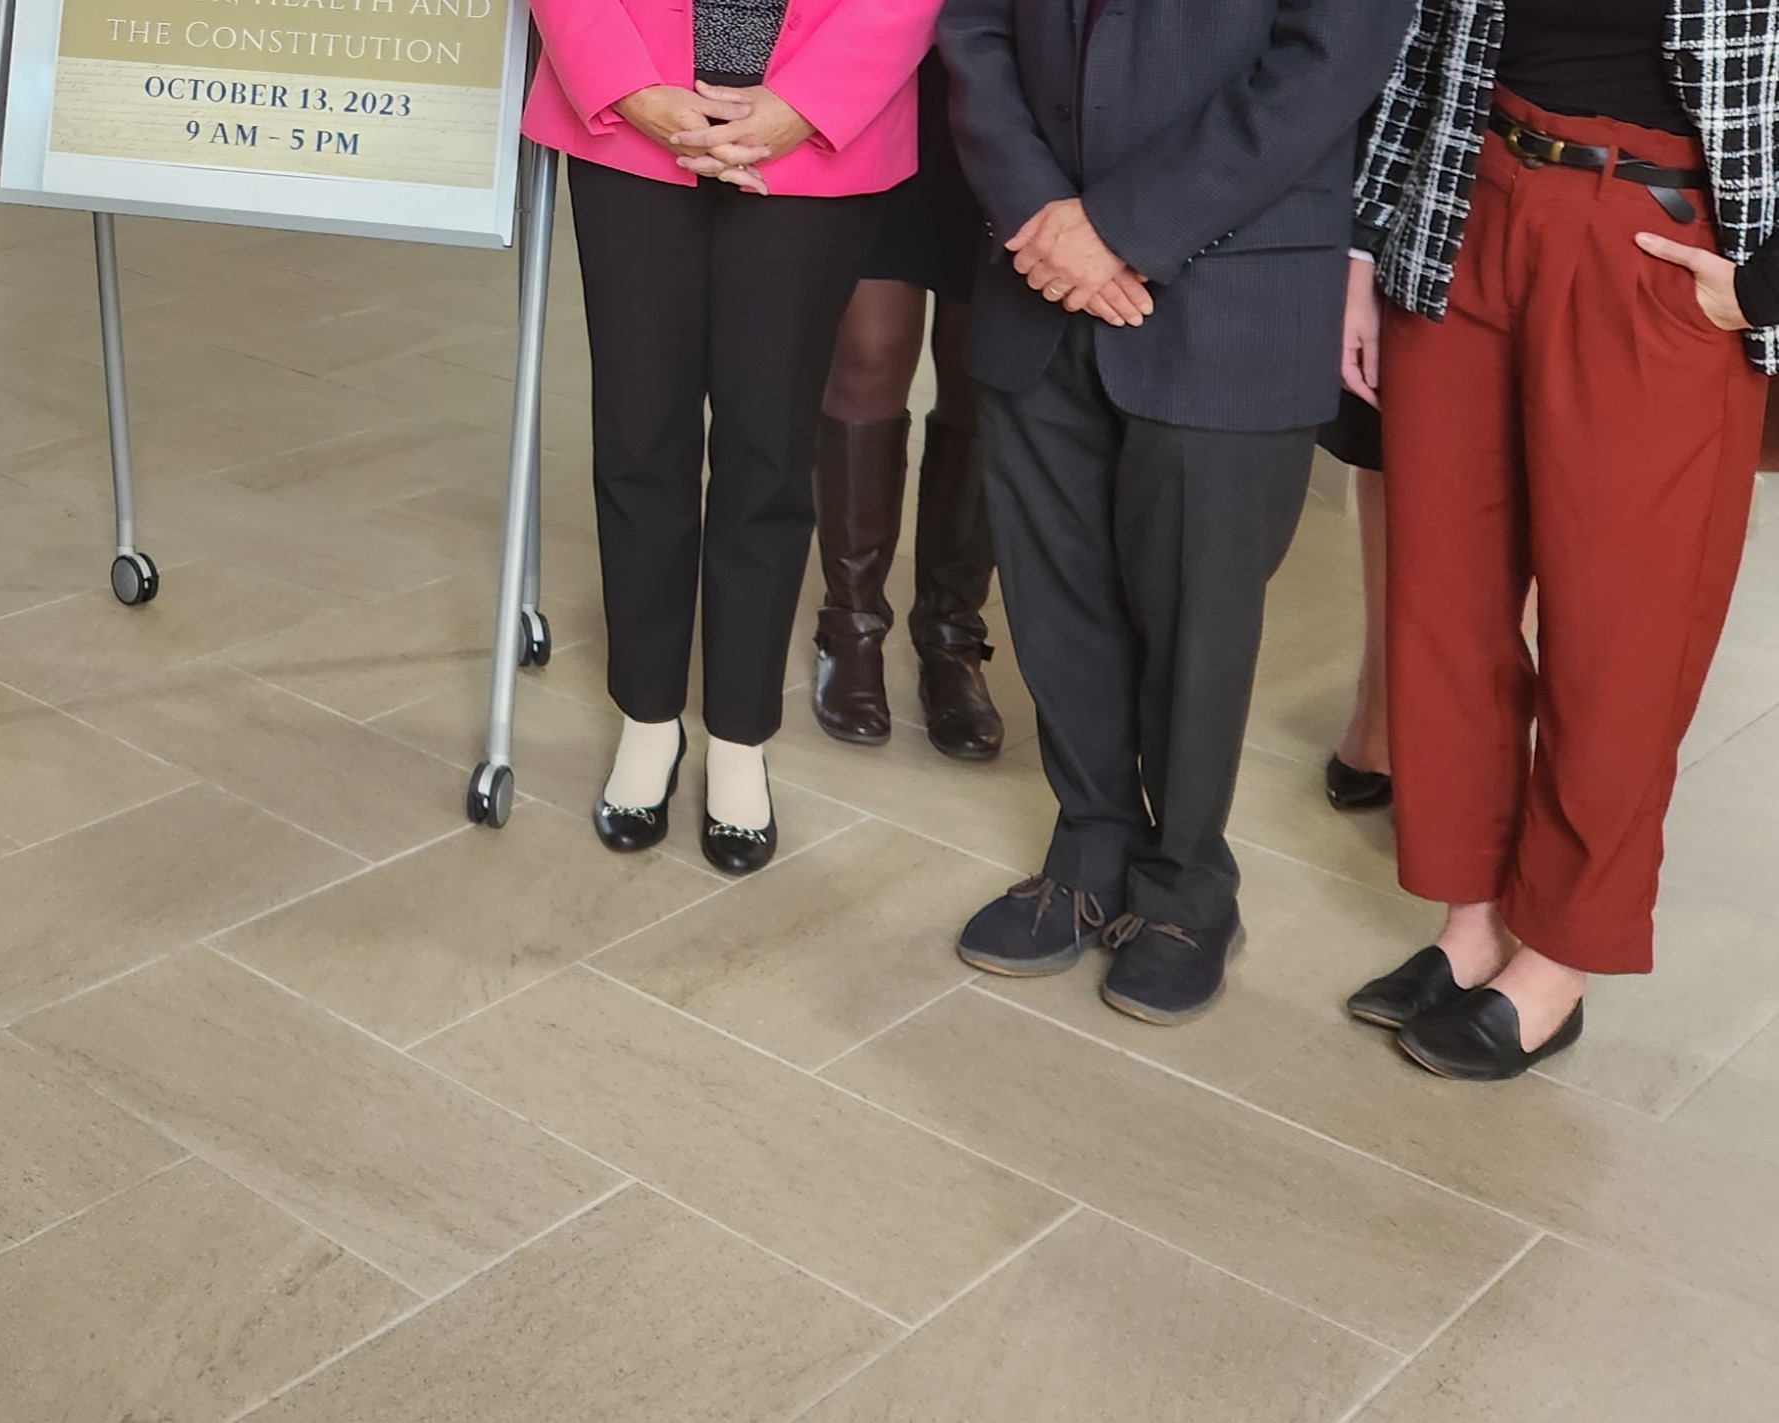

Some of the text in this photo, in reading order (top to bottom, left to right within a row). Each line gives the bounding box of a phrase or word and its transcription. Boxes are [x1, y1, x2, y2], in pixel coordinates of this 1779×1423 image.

[107, 18, 463, 65] THE CONSTITUTION
[144, 76, 412, 117] OCTOBER 13, 2023
[186, 120, 200, 141] 9
[210, 122, 259, 147] AM
[290, 128, 306, 151] 5
[314, 130, 361, 156] PM
